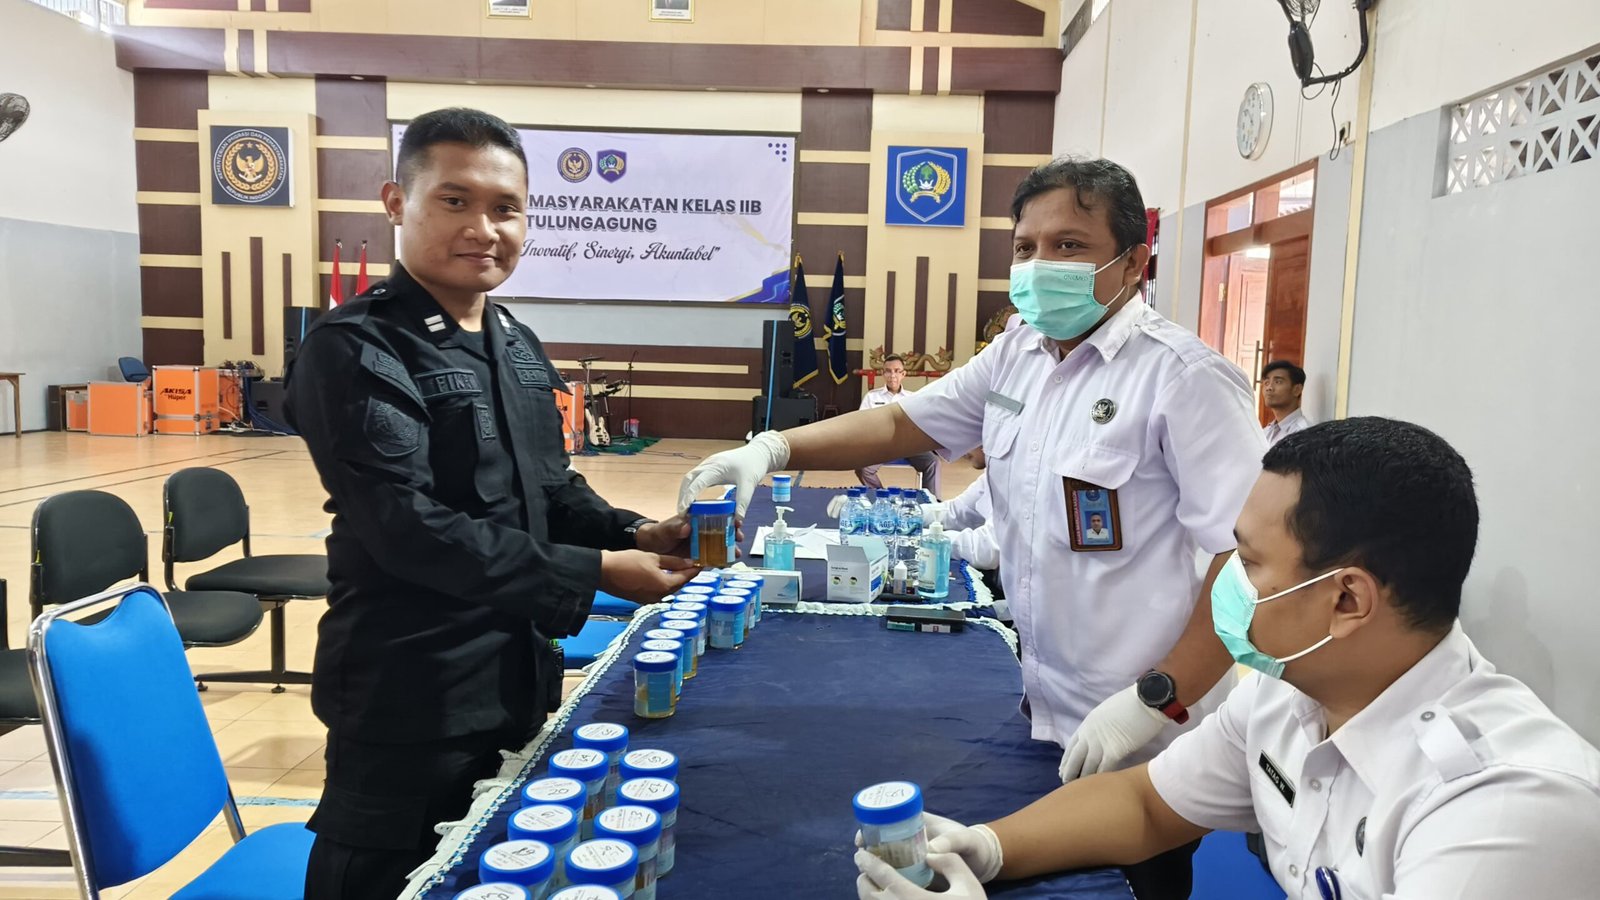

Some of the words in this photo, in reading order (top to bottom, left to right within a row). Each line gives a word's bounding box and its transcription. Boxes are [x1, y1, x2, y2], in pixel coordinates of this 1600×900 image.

[528, 194, 678, 212] MASYARAKATAN
[682, 198, 736, 214] KELAS
[739, 200, 762, 214] IIB
[527, 215, 657, 232] TULUNGAGUNG
[520, 239, 578, 261] Inovatif,
[583, 240, 635, 264] Sinergi,
